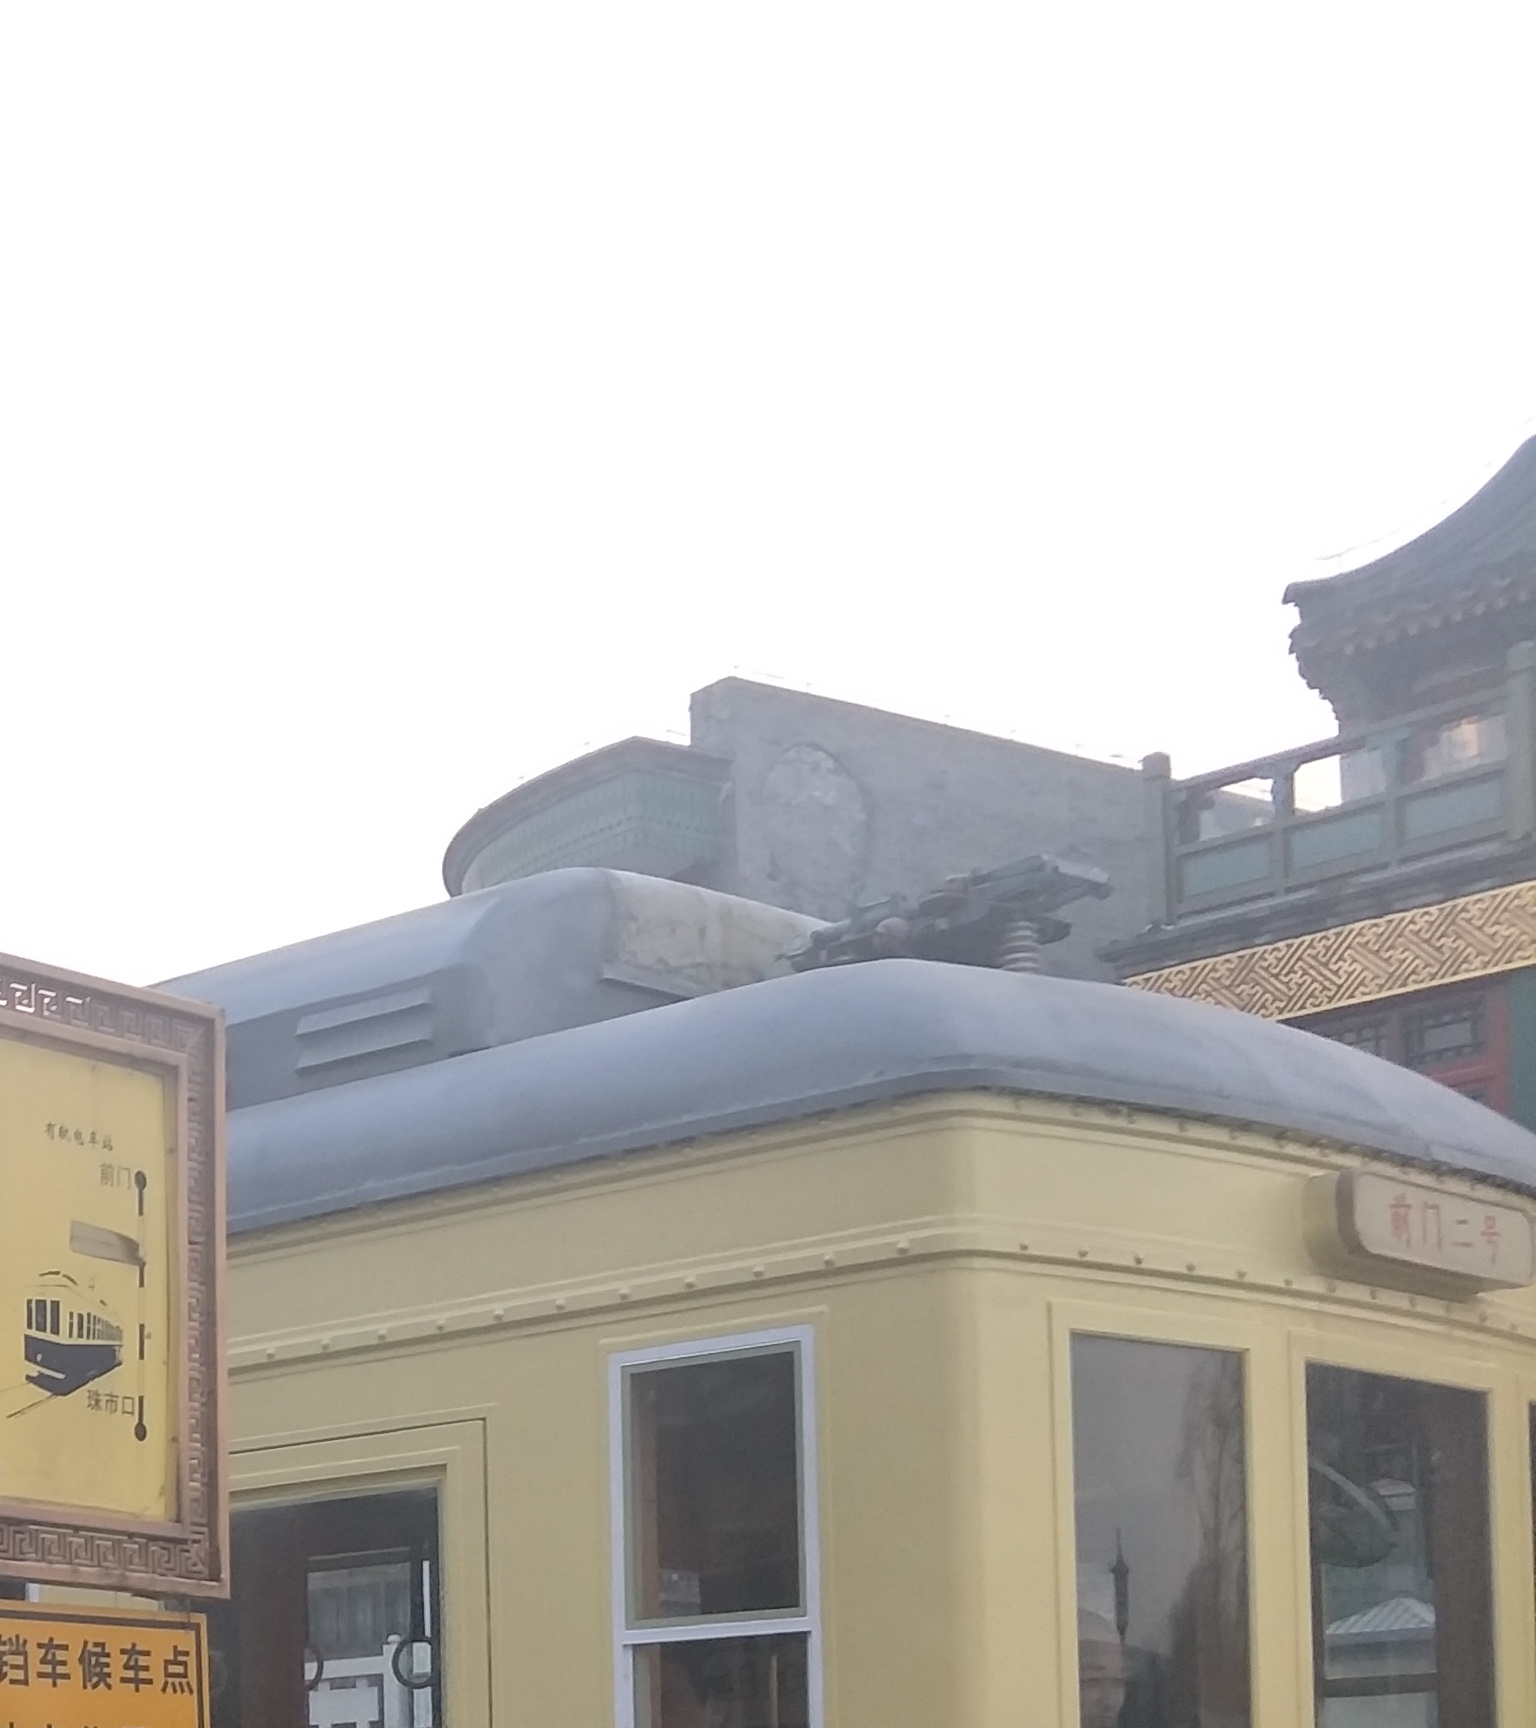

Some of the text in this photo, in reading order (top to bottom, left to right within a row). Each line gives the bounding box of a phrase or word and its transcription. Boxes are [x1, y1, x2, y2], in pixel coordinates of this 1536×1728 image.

[98, 1162, 132, 1190] 前门
[86, 1388, 136, 1417] 珠市口
